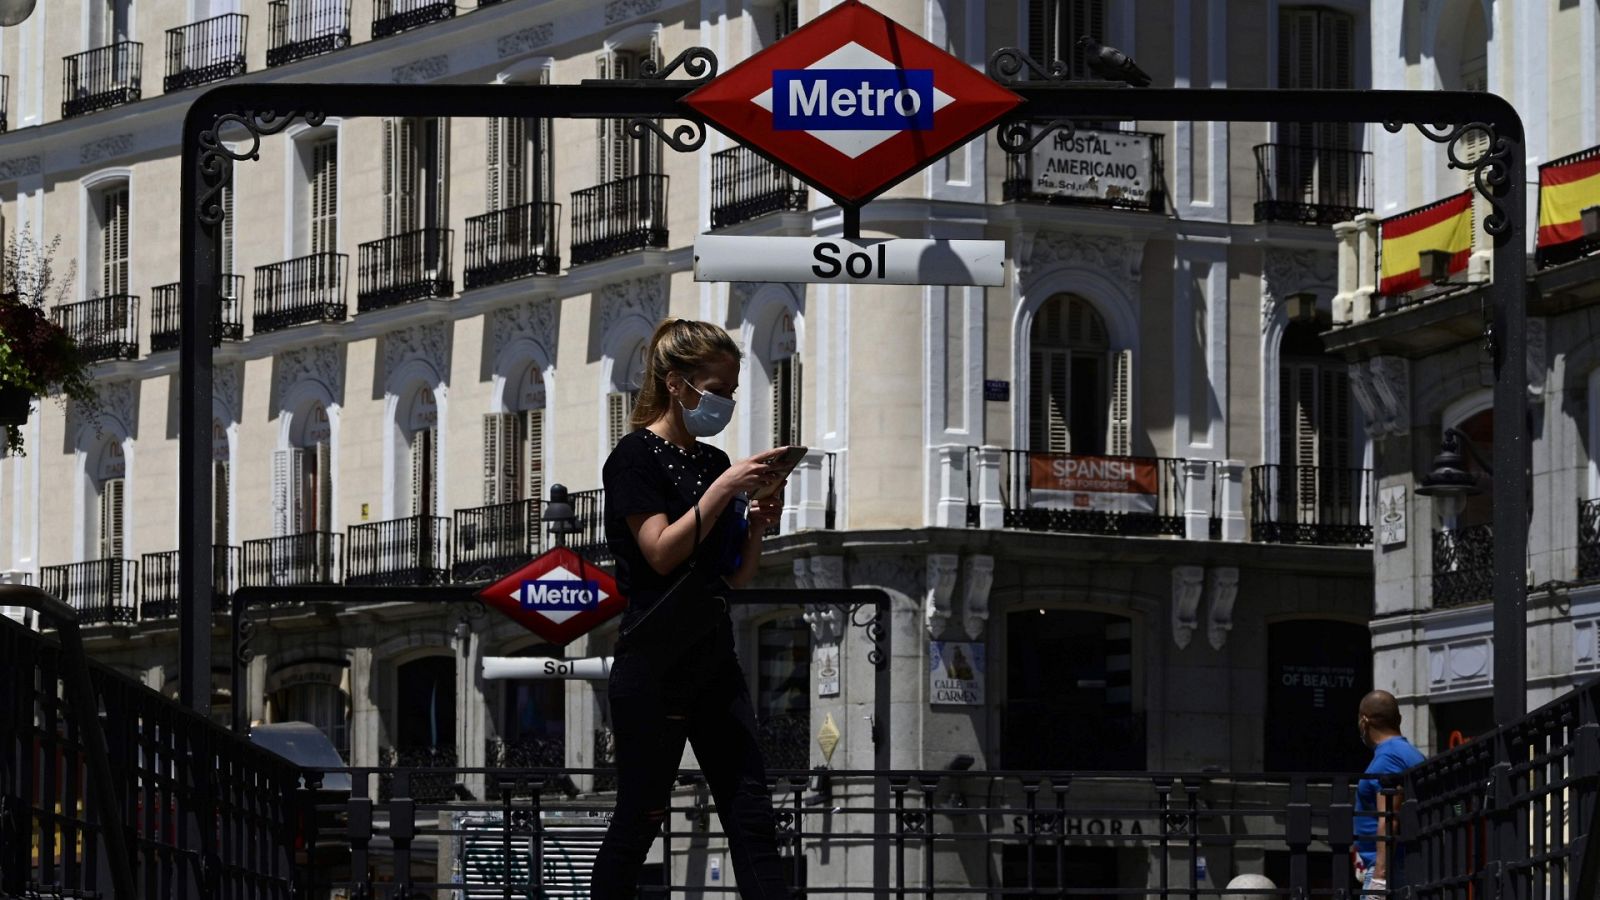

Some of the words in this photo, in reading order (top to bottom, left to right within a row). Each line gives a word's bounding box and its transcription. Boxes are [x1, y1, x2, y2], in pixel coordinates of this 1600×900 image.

[789, 79, 921, 117] Metro
[1053, 135, 1112, 156] HOSTAL
[1046, 157, 1137, 180] AMERICANO
[812, 242, 885, 279] Sol
[1053, 459, 1136, 480] SPANISH
[1059, 479, 1076, 488] FOR
[527, 584, 593, 605] Metro
[543, 661, 574, 676] Sol
[934, 680, 961, 690] CALLE
[1282, 673, 1301, 687] OF
[1303, 674, 1355, 689] BEAUTY
[937, 689, 977, 702] CARMEN
[1013, 816, 1143, 835] SHORA
